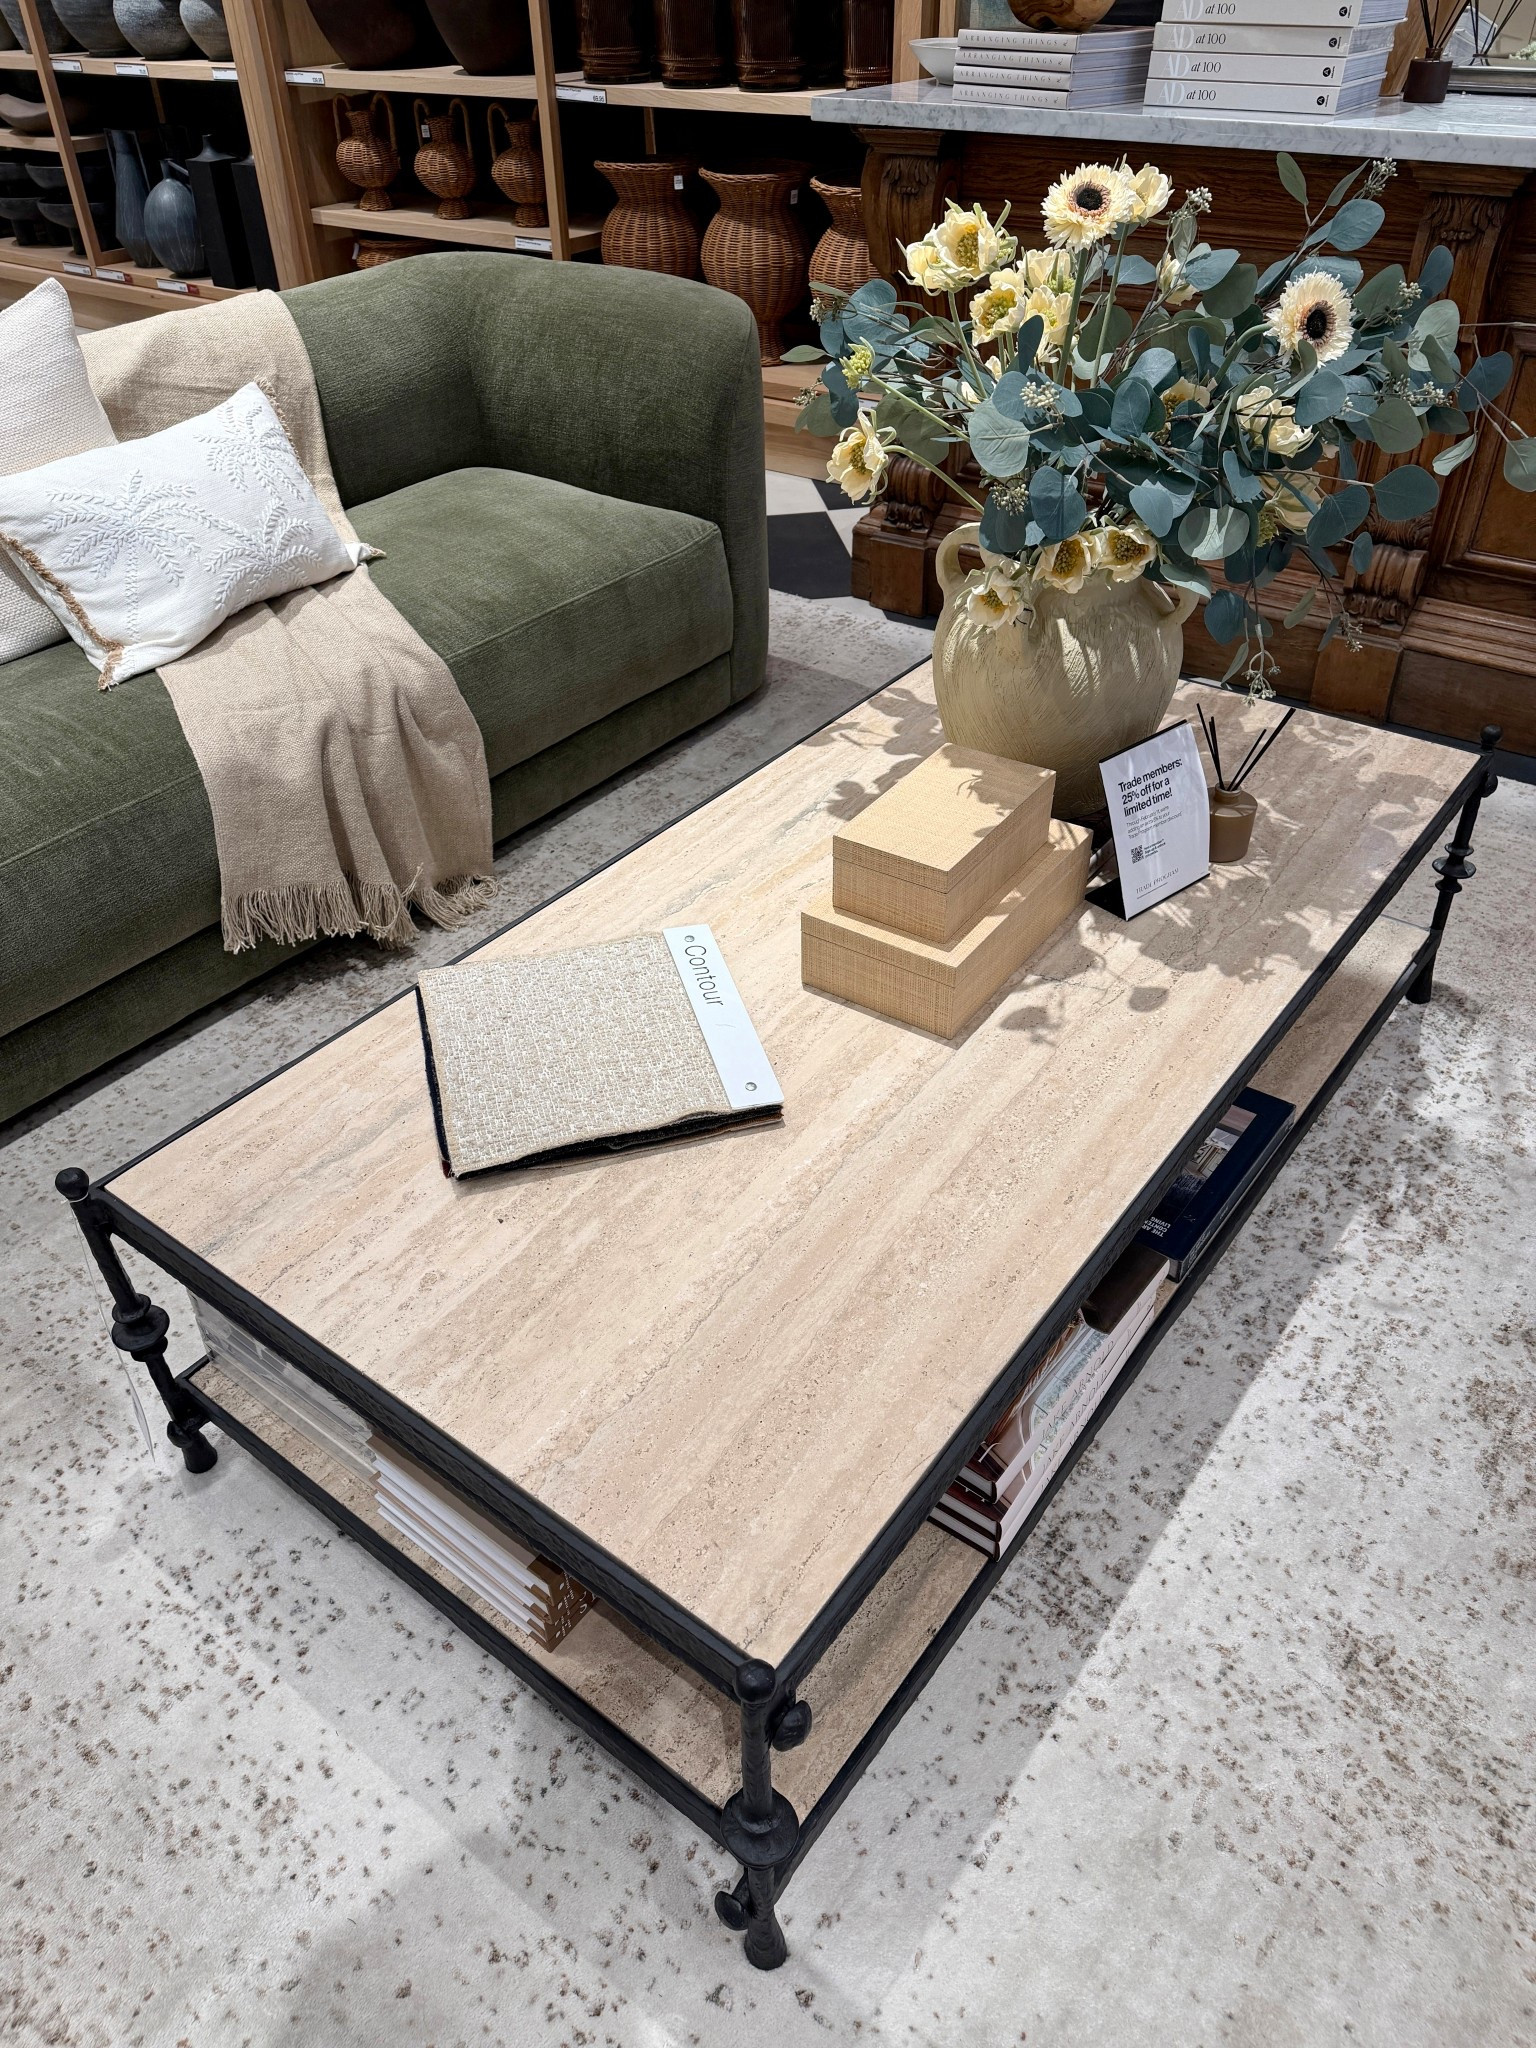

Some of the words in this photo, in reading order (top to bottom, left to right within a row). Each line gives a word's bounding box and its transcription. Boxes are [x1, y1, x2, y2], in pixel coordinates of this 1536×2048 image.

[1175, 0, 1203, 20] AD
[1205, 3, 1215, 15] at
[1217, 3, 1236, 15] 100
[965, 35, 1017, 44] ARRANGING
[1022, 38, 1058, 47] THINGS
[1168, 26, 1194, 50] AD
[1196, 34, 1206, 45] at
[1207, 33, 1226, 45] 100
[962, 52, 1014, 61] ARRANGING
[1018, 55, 1053, 64] THINGS
[1162, 54, 1190, 78] AD
[1191, 62, 1201, 73] at
[1203, 62, 1222, 73] 100
[960, 71, 1012, 80] ARRANGING
[1016, 74, 1051, 83] THINGS
[959, 89, 1010, 99] ARRANGING
[1014, 93, 1049, 103] THINGS
[1157, 82, 1185, 105] AD
[1186, 90, 1197, 100] at
[1198, 89, 1216, 101] 100
[1118, 776, 1142, 792] Trade
[1142, 758, 1183, 782] members:
[1121, 789, 1140, 805] 25%
[1140, 783, 1152, 797] off
[1152, 780, 1164, 792] for
[1164, 777, 1170, 786] a
[1124, 796, 1152, 817] limited
[1152, 787, 1173, 804] time!
[684, 945, 724, 1006] Contour
[1149, 1216, 1172, 1229] LIVING
[1151, 1228, 1164, 1238] THE
[1042, 1401, 1067, 1439] JAKE
[1073, 1341, 1114, 1398] ARNOLD
[1070, 1370, 1107, 1431] ARNOLD
